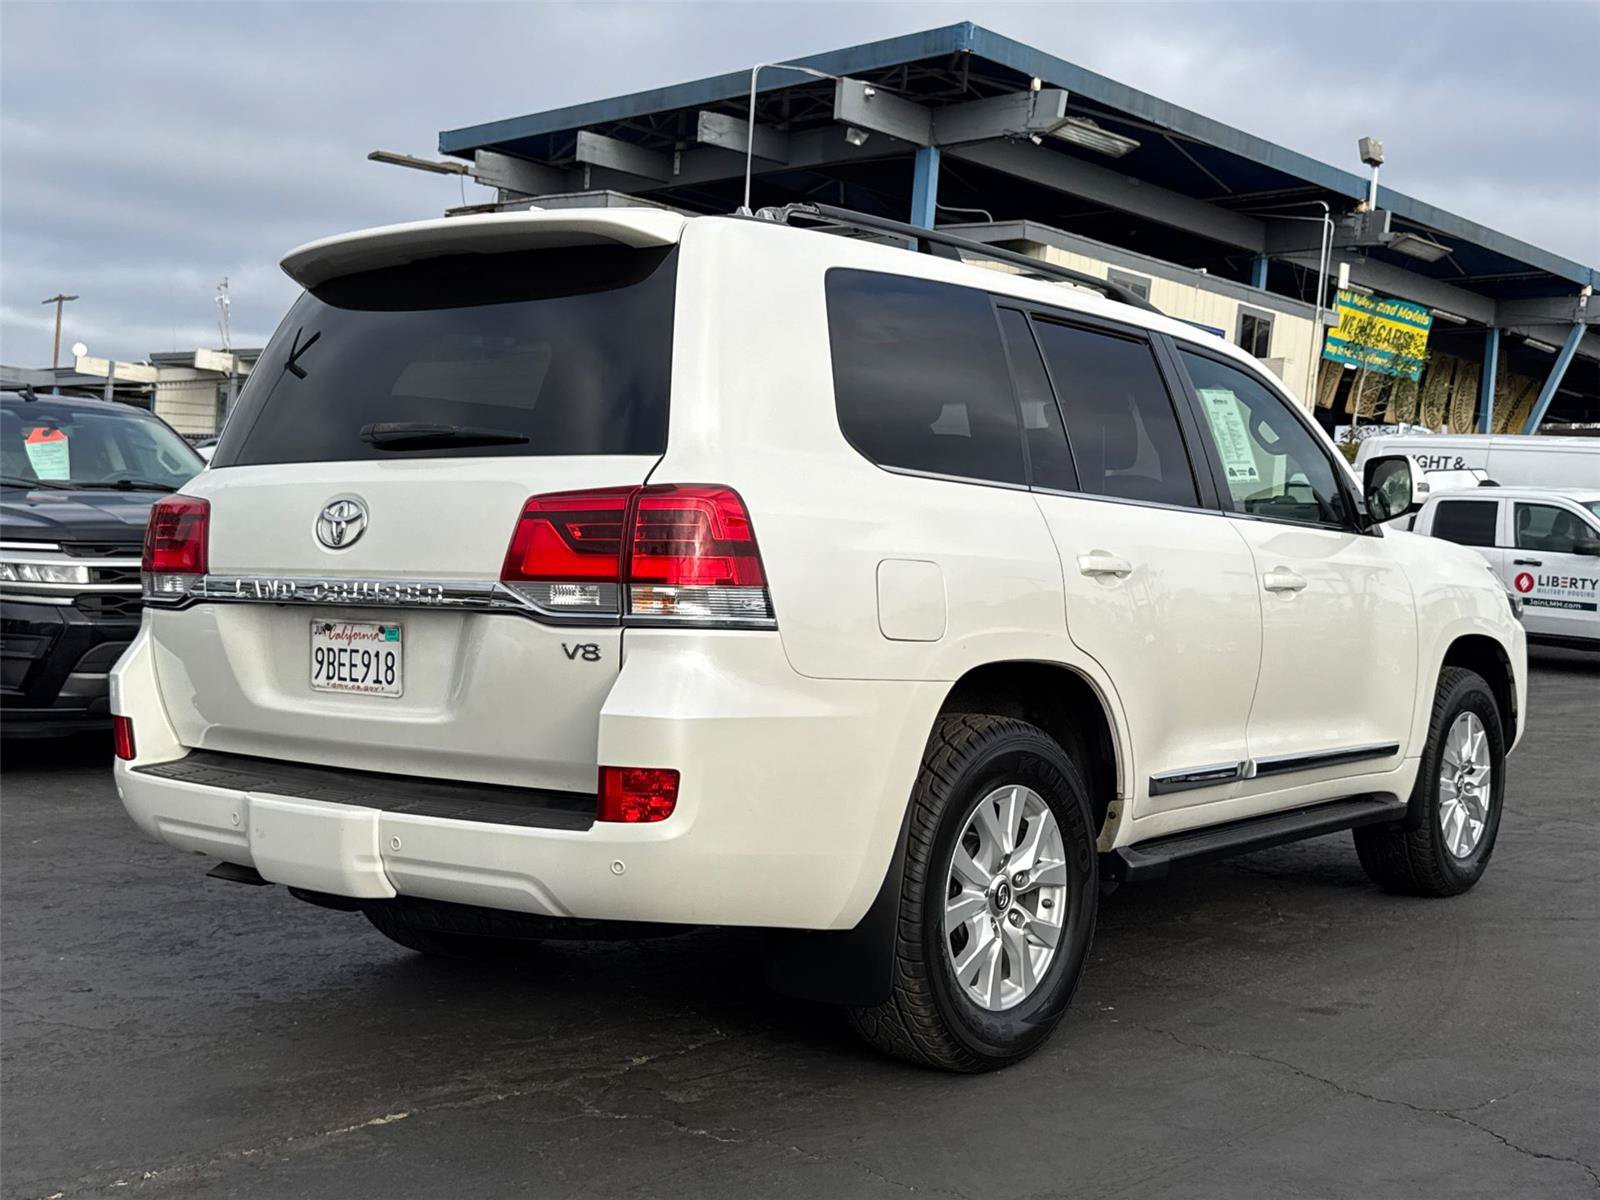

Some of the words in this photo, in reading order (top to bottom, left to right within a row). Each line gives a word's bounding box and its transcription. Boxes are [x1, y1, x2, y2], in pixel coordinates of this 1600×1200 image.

[1376, 302, 1397, 315] and
[1397, 307, 1429, 325] Models
[1413, 455, 1452, 469] GHT
[1537, 574, 1599, 590] LIBERTY
[328, 623, 384, 646] California
[561, 643, 602, 661] V8
[314, 646, 396, 686] 9BEE918
